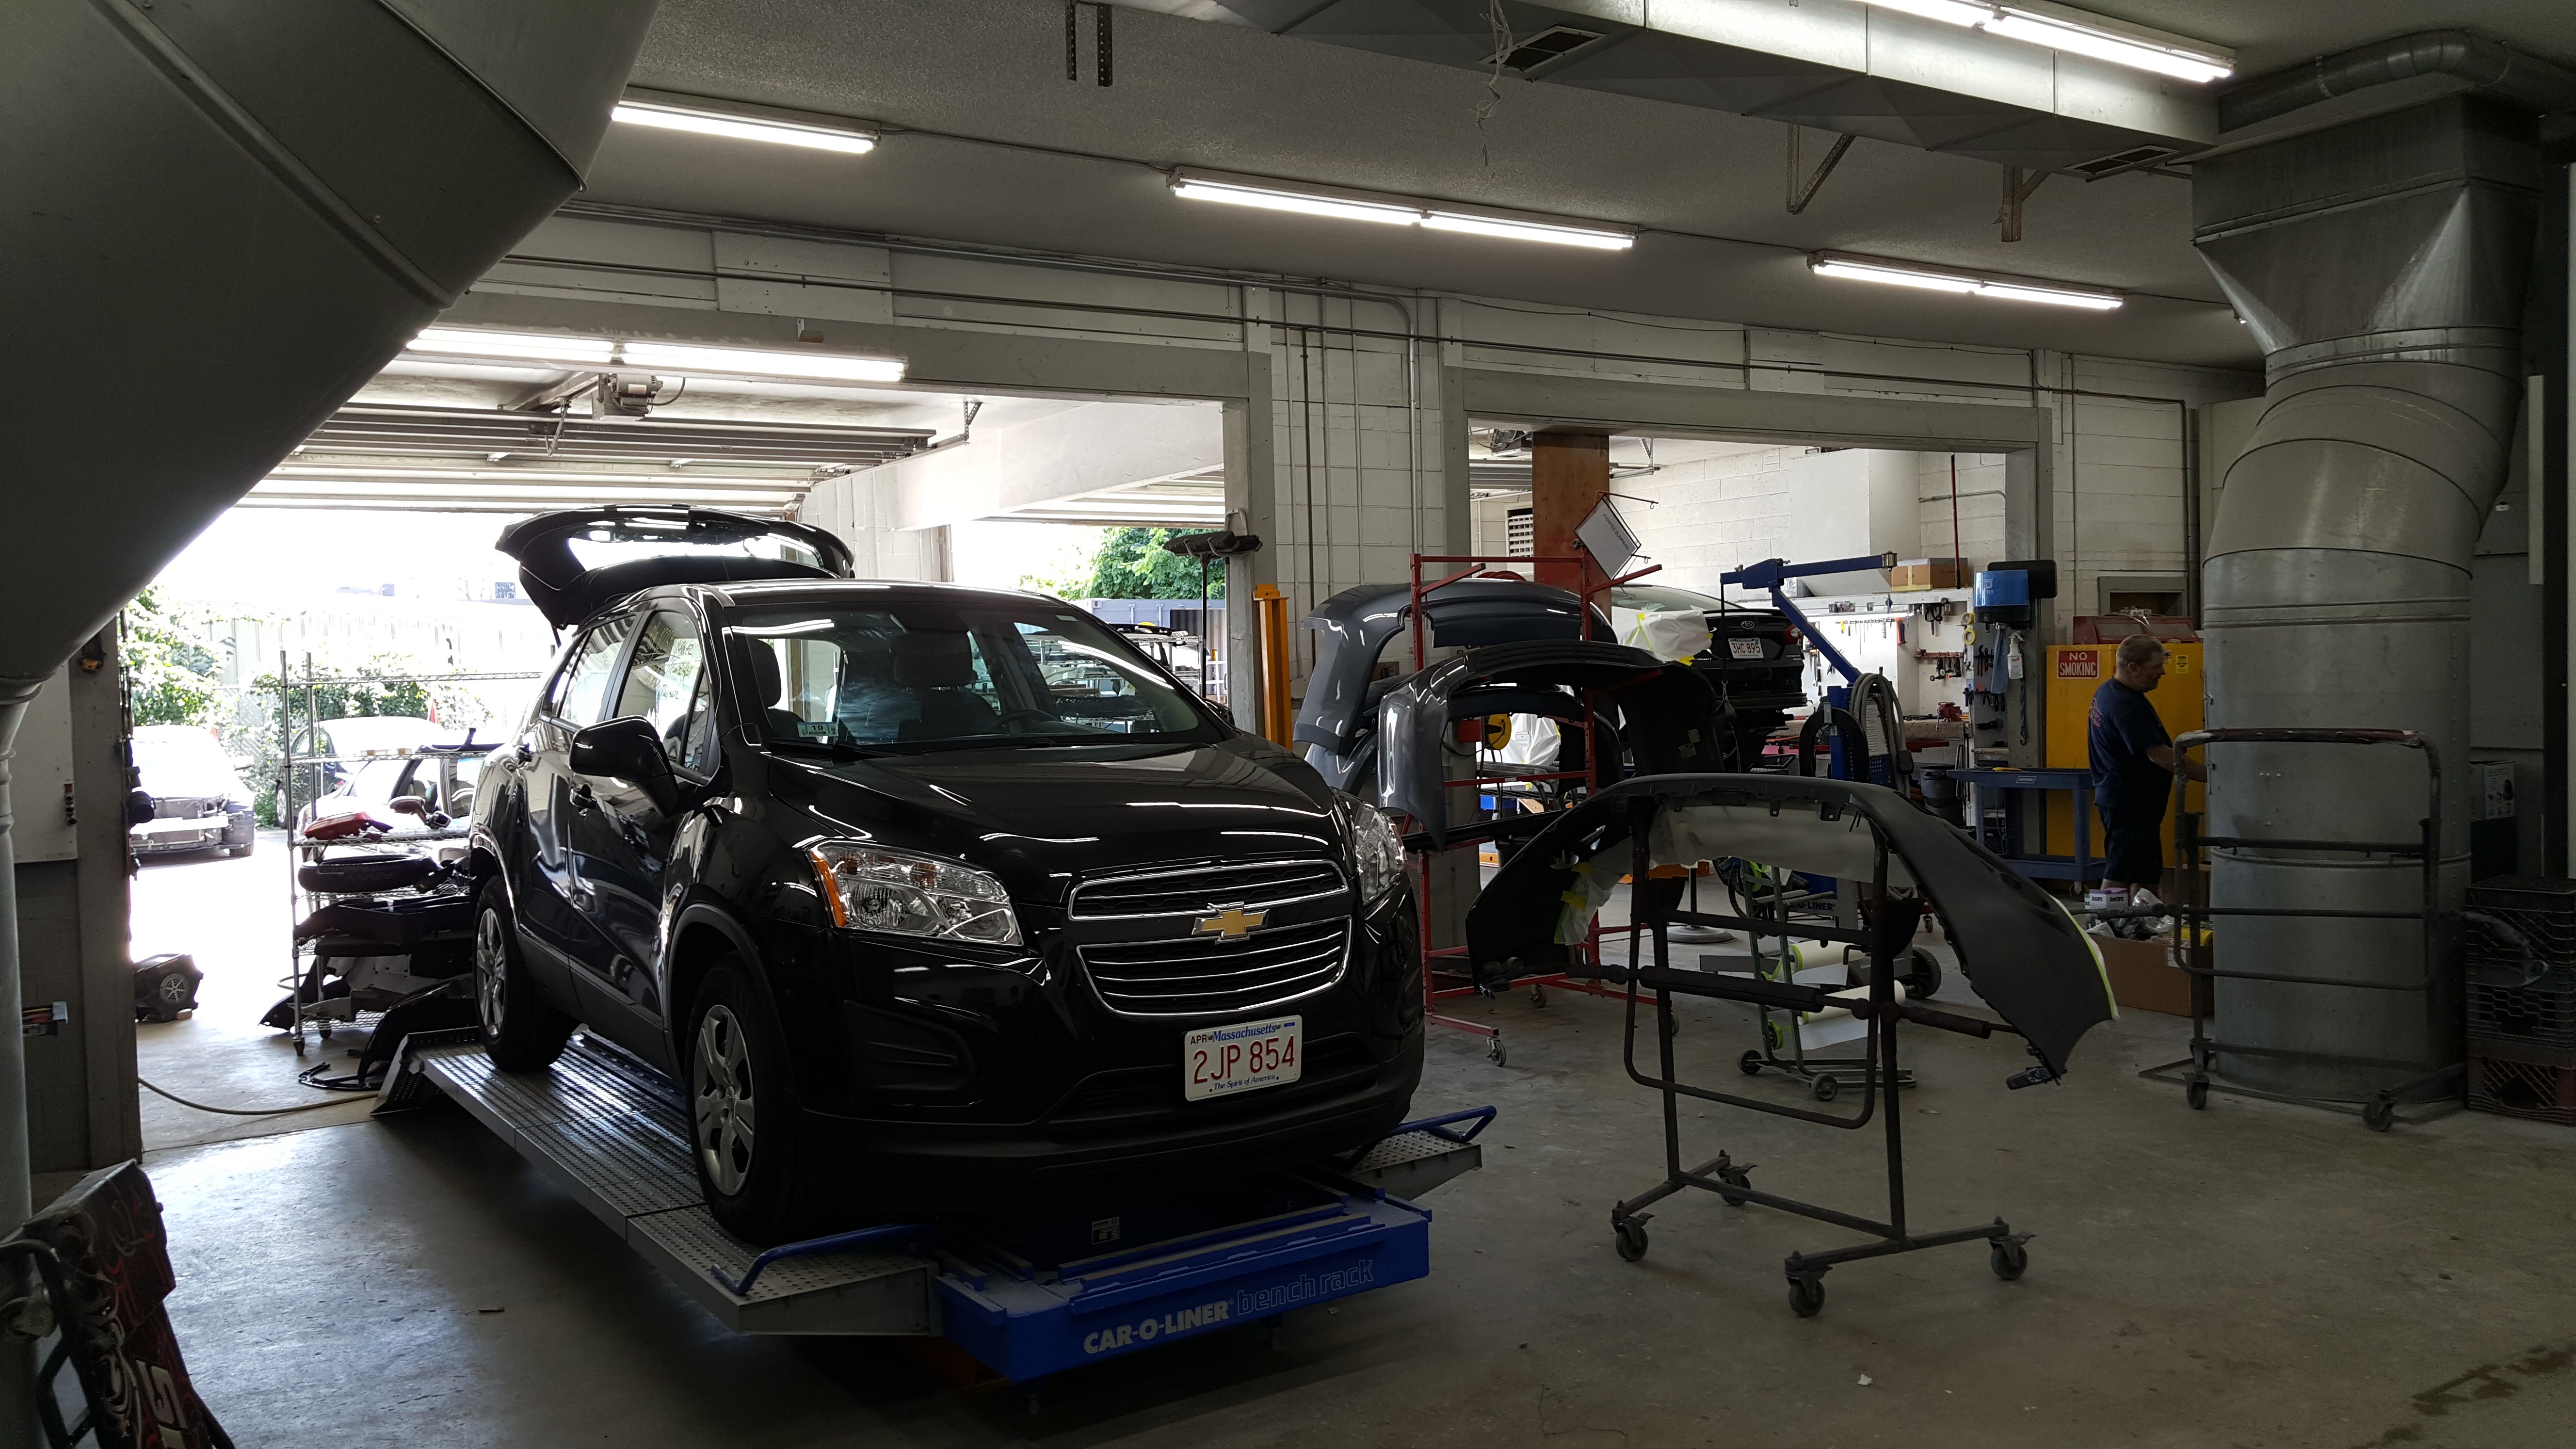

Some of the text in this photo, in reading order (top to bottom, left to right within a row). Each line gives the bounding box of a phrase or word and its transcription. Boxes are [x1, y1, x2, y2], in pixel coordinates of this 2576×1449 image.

[1603, 514, 1629, 550] PAINTED BUMPERS
[1731, 643, 1760, 653] 3HC 895
[2069, 652, 2087, 660] NO
[2060, 661, 2096, 676] SMOKING
[1190, 1023, 1277, 1045] APR Massachusetts
[1193, 1035, 1294, 1084] 2JP 854
[1213, 1074, 1275, 1091] The Spirit of America
[1237, 1273, 1316, 1316] bench
[1319, 1258, 1374, 1295] rack
